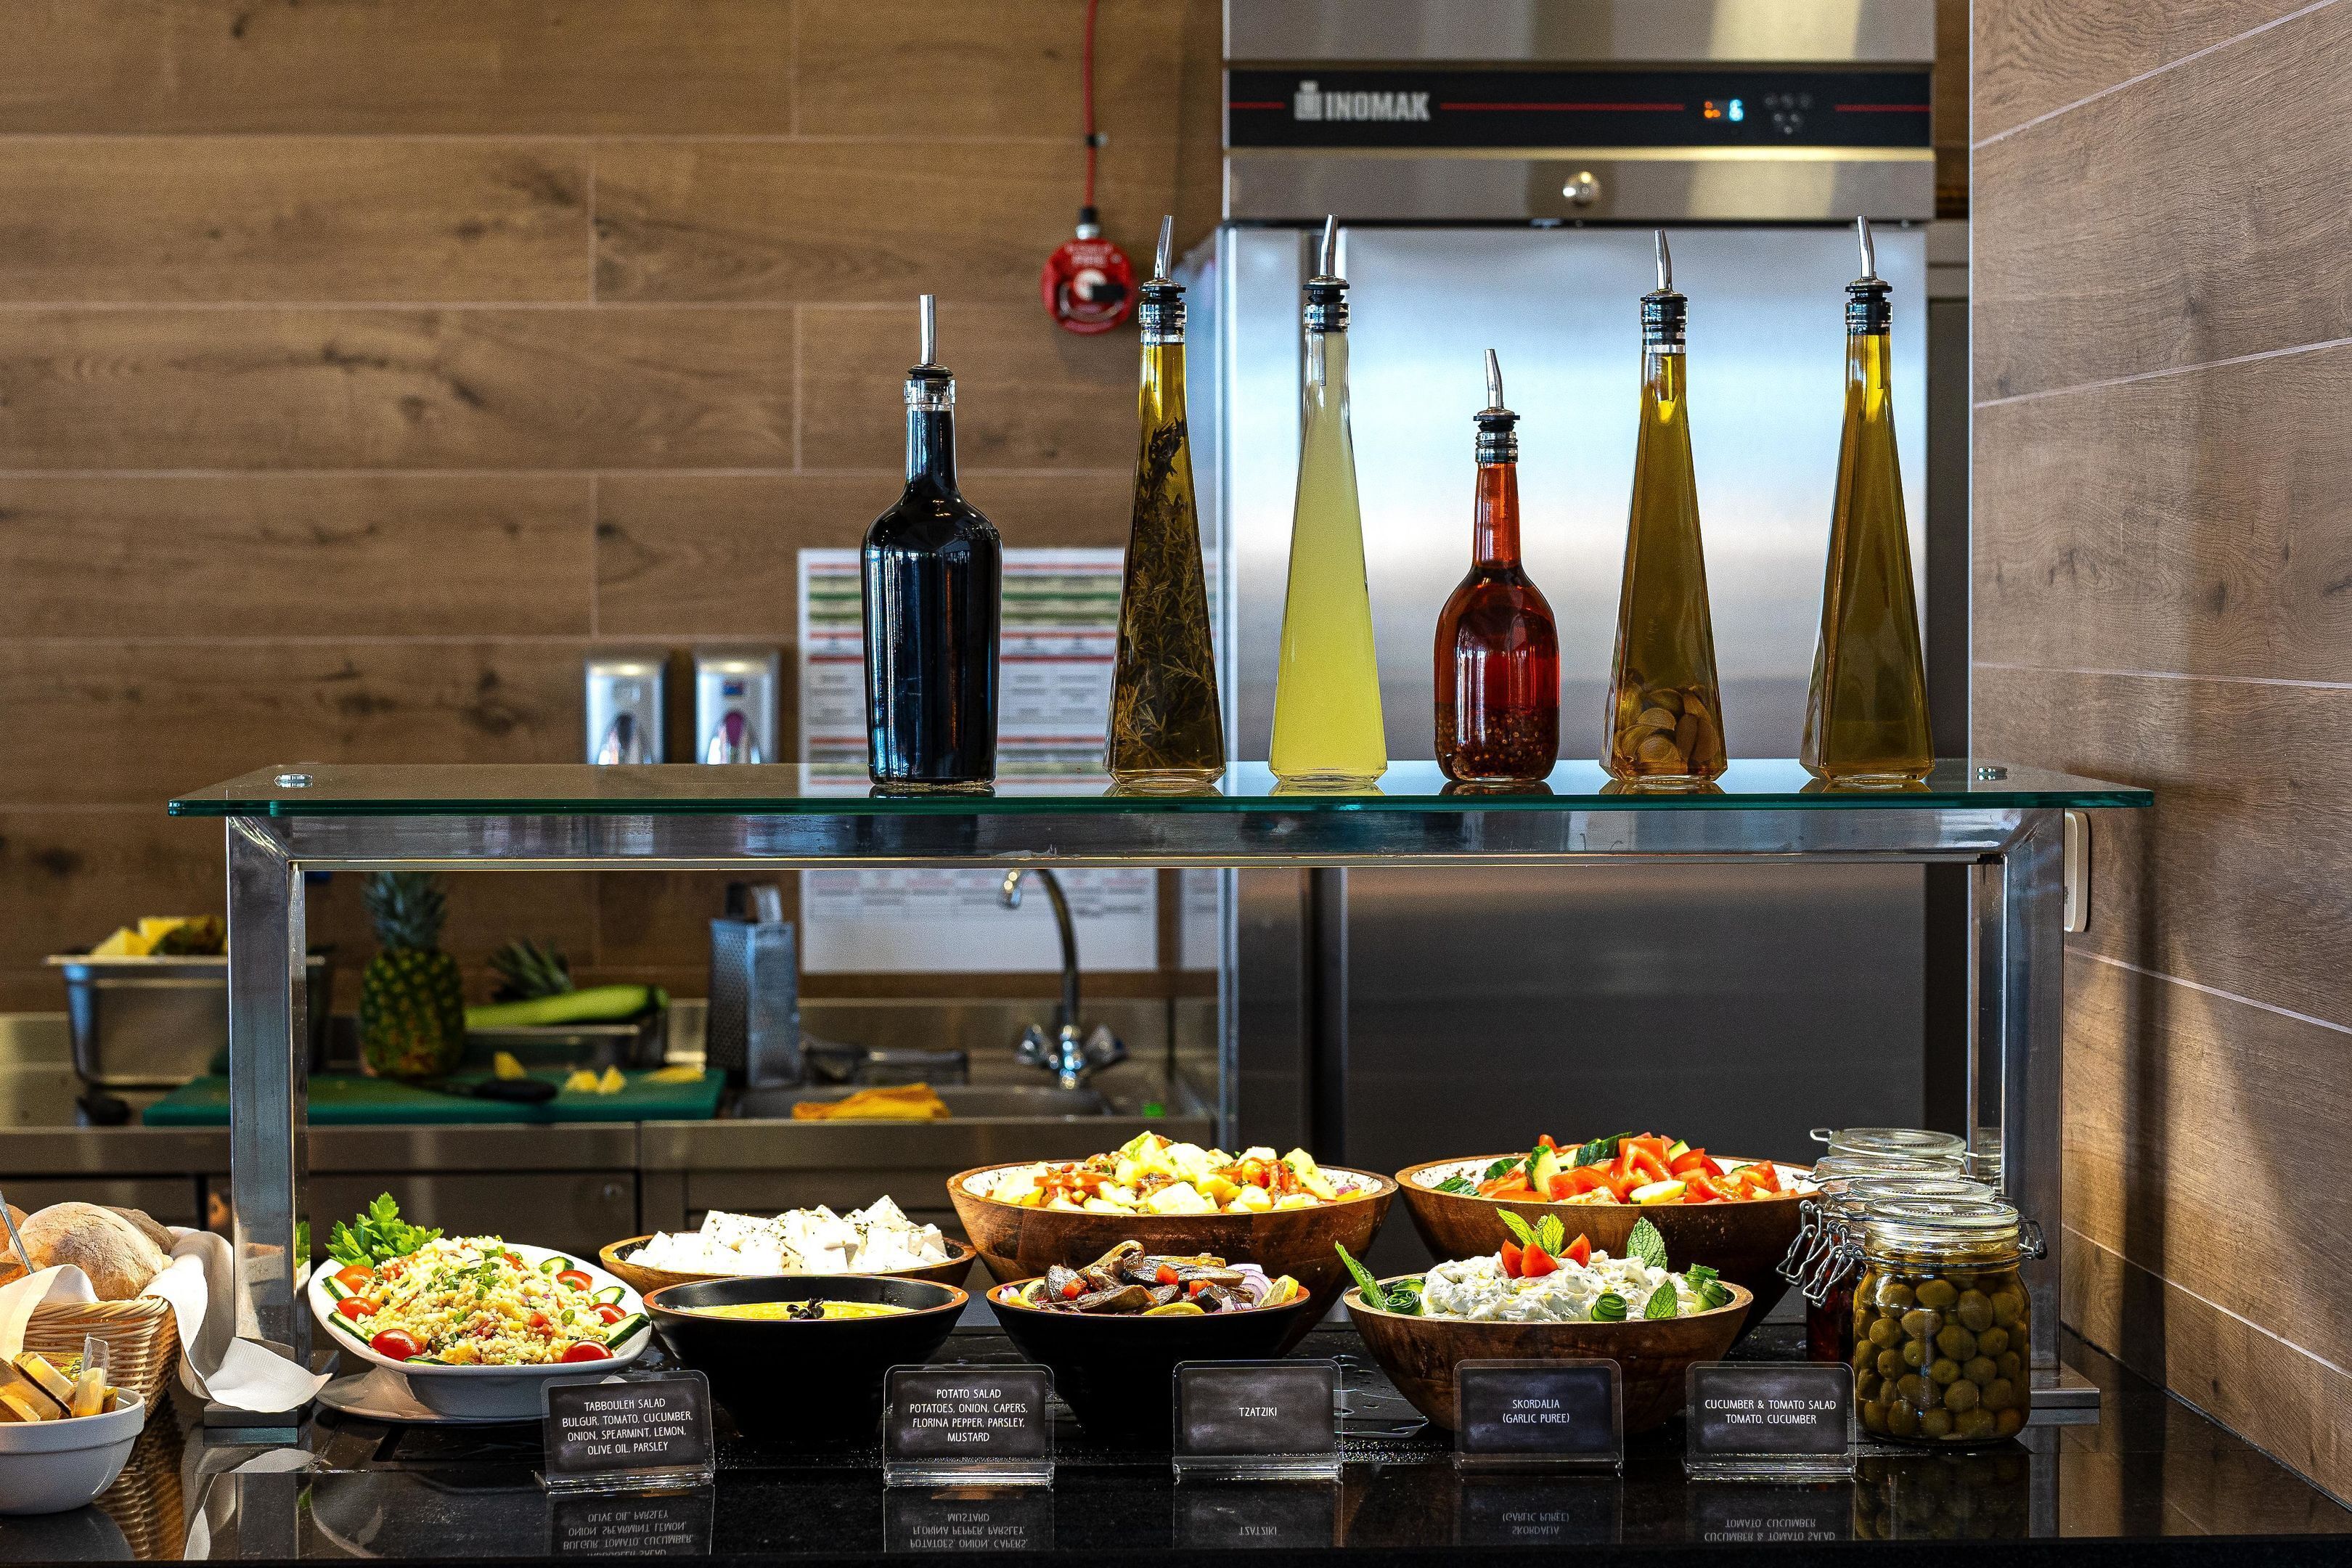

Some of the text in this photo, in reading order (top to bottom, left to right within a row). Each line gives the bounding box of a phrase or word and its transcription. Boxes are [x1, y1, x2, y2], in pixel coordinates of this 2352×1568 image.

[1326, 91, 1431, 121] INOMAK
[937, 1389, 1001, 1398] POTATO SALAD
[584, 1398, 665, 1411] TABBOULEH SALAD
[910, 1404, 1027, 1413] POTATOES, ONION, CAPERS,
[1513, 1400, 1559, 1408] SKORDALIA
[1705, 1400, 1836, 1409] CUCUMBER & TOMATO SALAD
[1238, 1407, 1277, 1416] TZATZIKI
[563, 1411, 693, 1427] BULGUR, TOMATO, CUCUMBER,
[913, 1418, 1024, 1427] FLORINA PEPPER, PARSLEY,
[1503, 1413, 1569, 1423] (GARLIC PUREE)
[1726, 1414, 1816, 1424] TOMATO, CUCUMBER
[568, 1426, 686, 1441] ONION, SPEARMINT, LEMON,
[948, 1433, 989, 1442] MUSTARD
[588, 1442, 668, 1455] OLIVE OIL, PARSLEY
